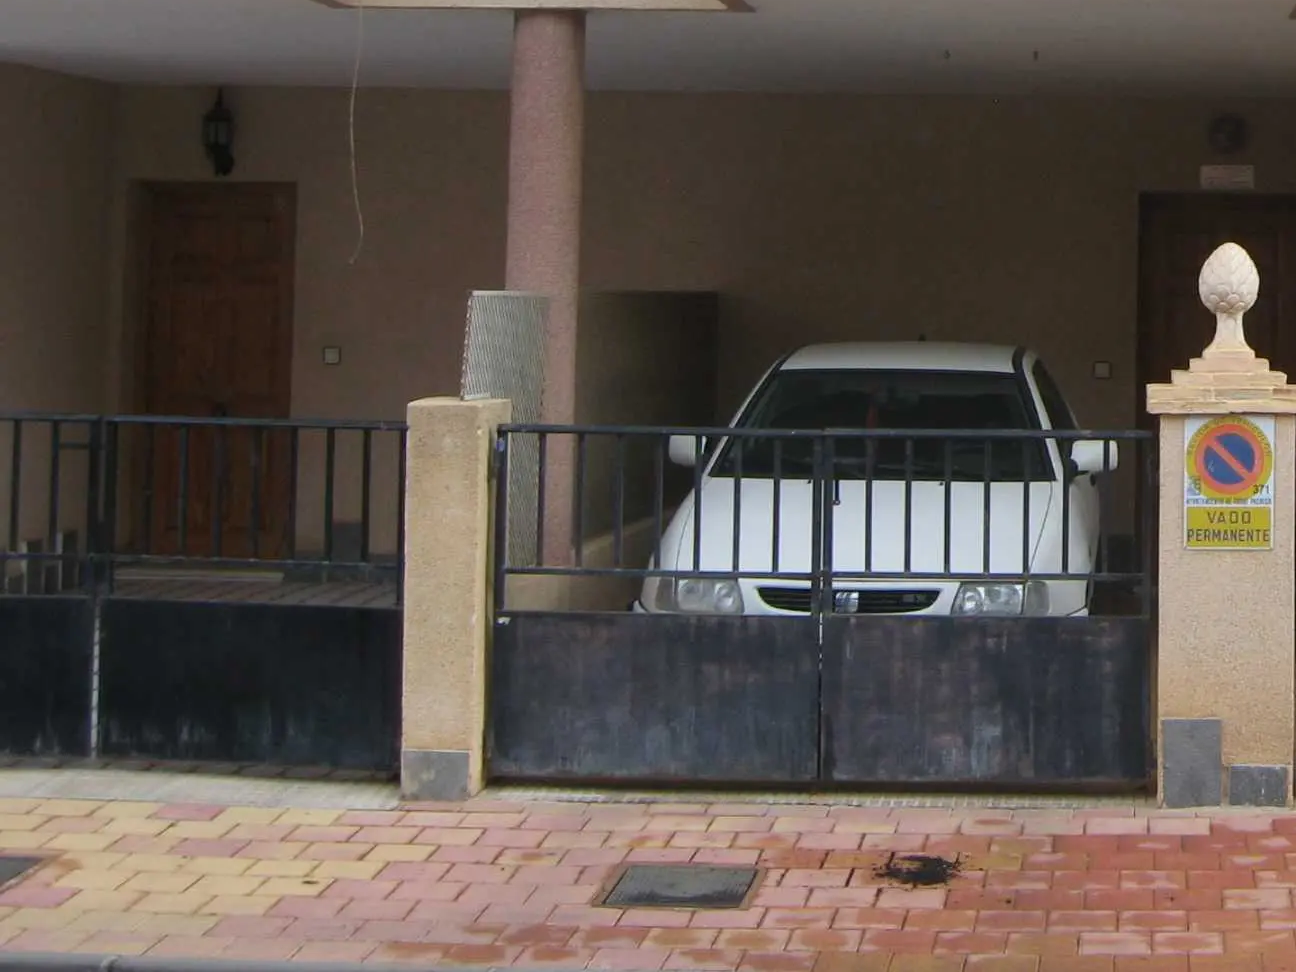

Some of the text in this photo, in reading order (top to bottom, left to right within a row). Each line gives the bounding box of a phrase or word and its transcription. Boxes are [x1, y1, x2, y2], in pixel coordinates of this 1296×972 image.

[1253, 484, 1269, 494] 371
[1207, 510, 1251, 524] VADO
[1187, 528, 1270, 542] PERMANENTE
